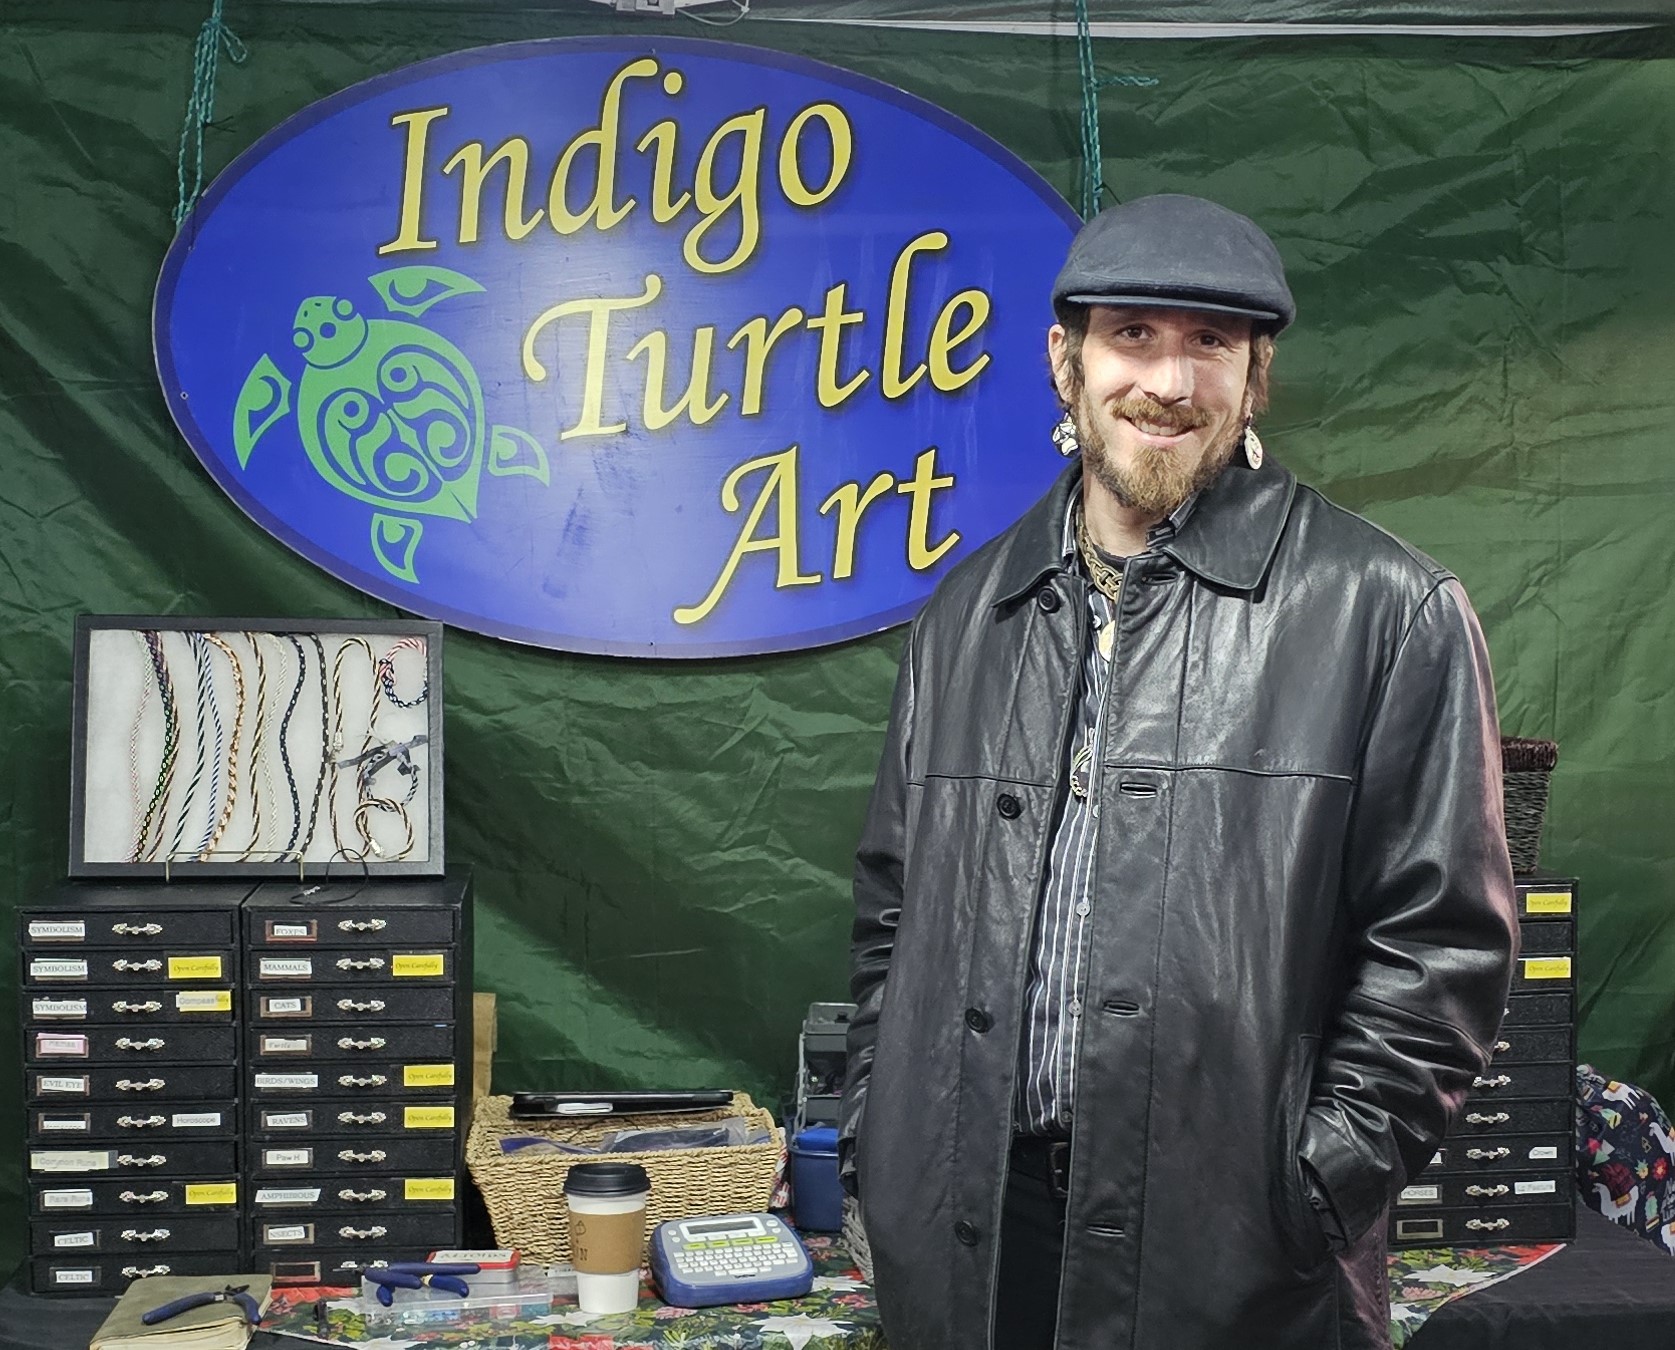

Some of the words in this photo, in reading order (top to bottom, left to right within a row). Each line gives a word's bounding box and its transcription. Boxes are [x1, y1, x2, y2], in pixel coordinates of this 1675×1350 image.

[378, 58, 853, 273] Indigo
[522, 231, 991, 442] Turtle
[673, 446, 960, 625] Art
[31, 925, 83, 934] SYMBOLISM
[33, 964, 85, 974] SYMBOLISM
[173, 964, 190, 973] Open
[191, 963, 219, 973] Carefully
[264, 963, 308, 972] MAMMALS
[395, 962, 410, 971] Open
[411, 960, 438, 971] Carefully
[34, 1002, 86, 1012] SYMBOLISM
[274, 1001, 297, 1010] CATS
[43, 1079, 63, 1088] EVIL
[65, 1079, 82, 1089] EYE
[256, 1077, 316, 1085] BIRDS/WINGS
[272, 1116, 305, 1125] RAVENS
[276, 1153, 292, 1161] Paw
[261, 1191, 316, 1200] AMPHIBIOUS
[57, 1235, 88, 1246] CELTIC
[58, 1273, 90, 1281] CELTIC
